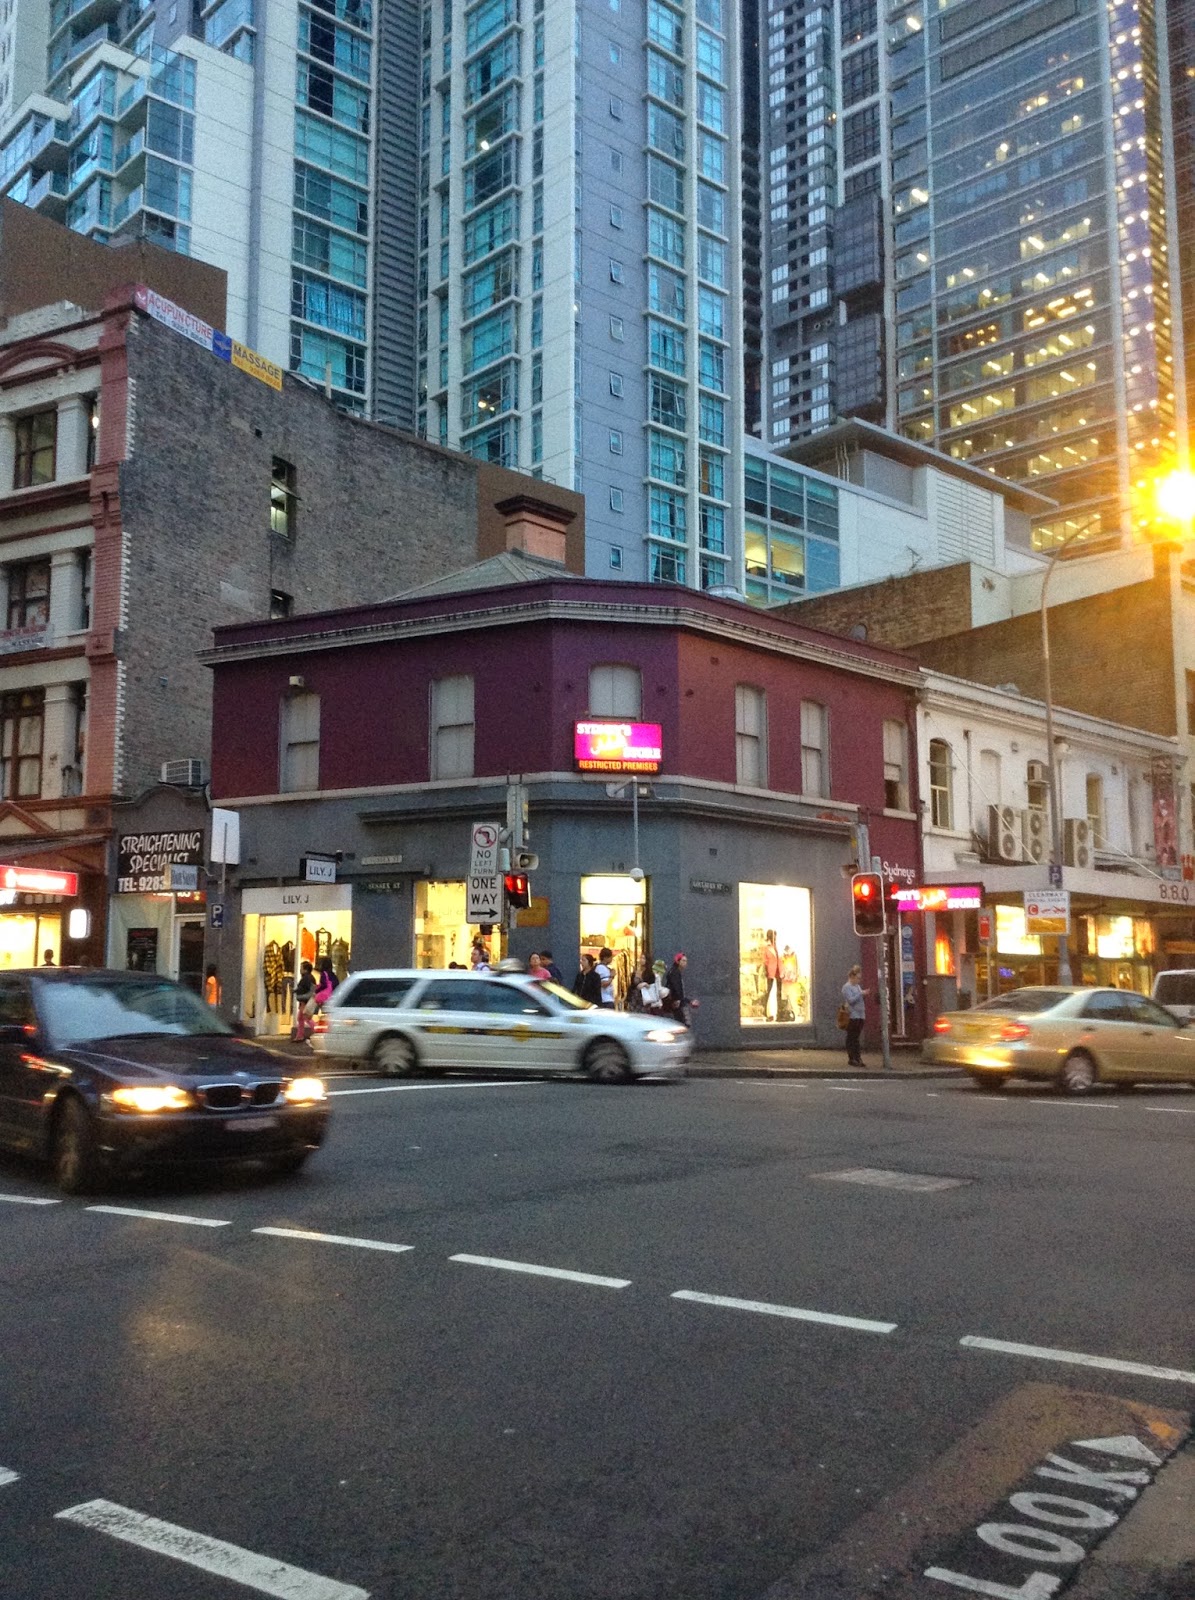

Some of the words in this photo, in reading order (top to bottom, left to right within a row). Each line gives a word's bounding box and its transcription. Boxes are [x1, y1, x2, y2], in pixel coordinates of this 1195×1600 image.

[148, 293, 212, 340] ACUPUNCTURE
[233, 344, 280, 379] MASSAGE
[579, 760, 621, 769] RESTRICTED
[623, 761, 658, 771] PREMISES
[120, 832, 201, 854] STRAIGHTENING
[476, 850, 491, 859] NO
[883, 861, 915, 884] Sydneys
[472, 878, 497, 889] ONE
[304, 895, 309, 904] J
[471, 894, 498, 905] WAY
[213, 905, 223, 919] P
[924, 1451, 1150, 1600] LOOK
